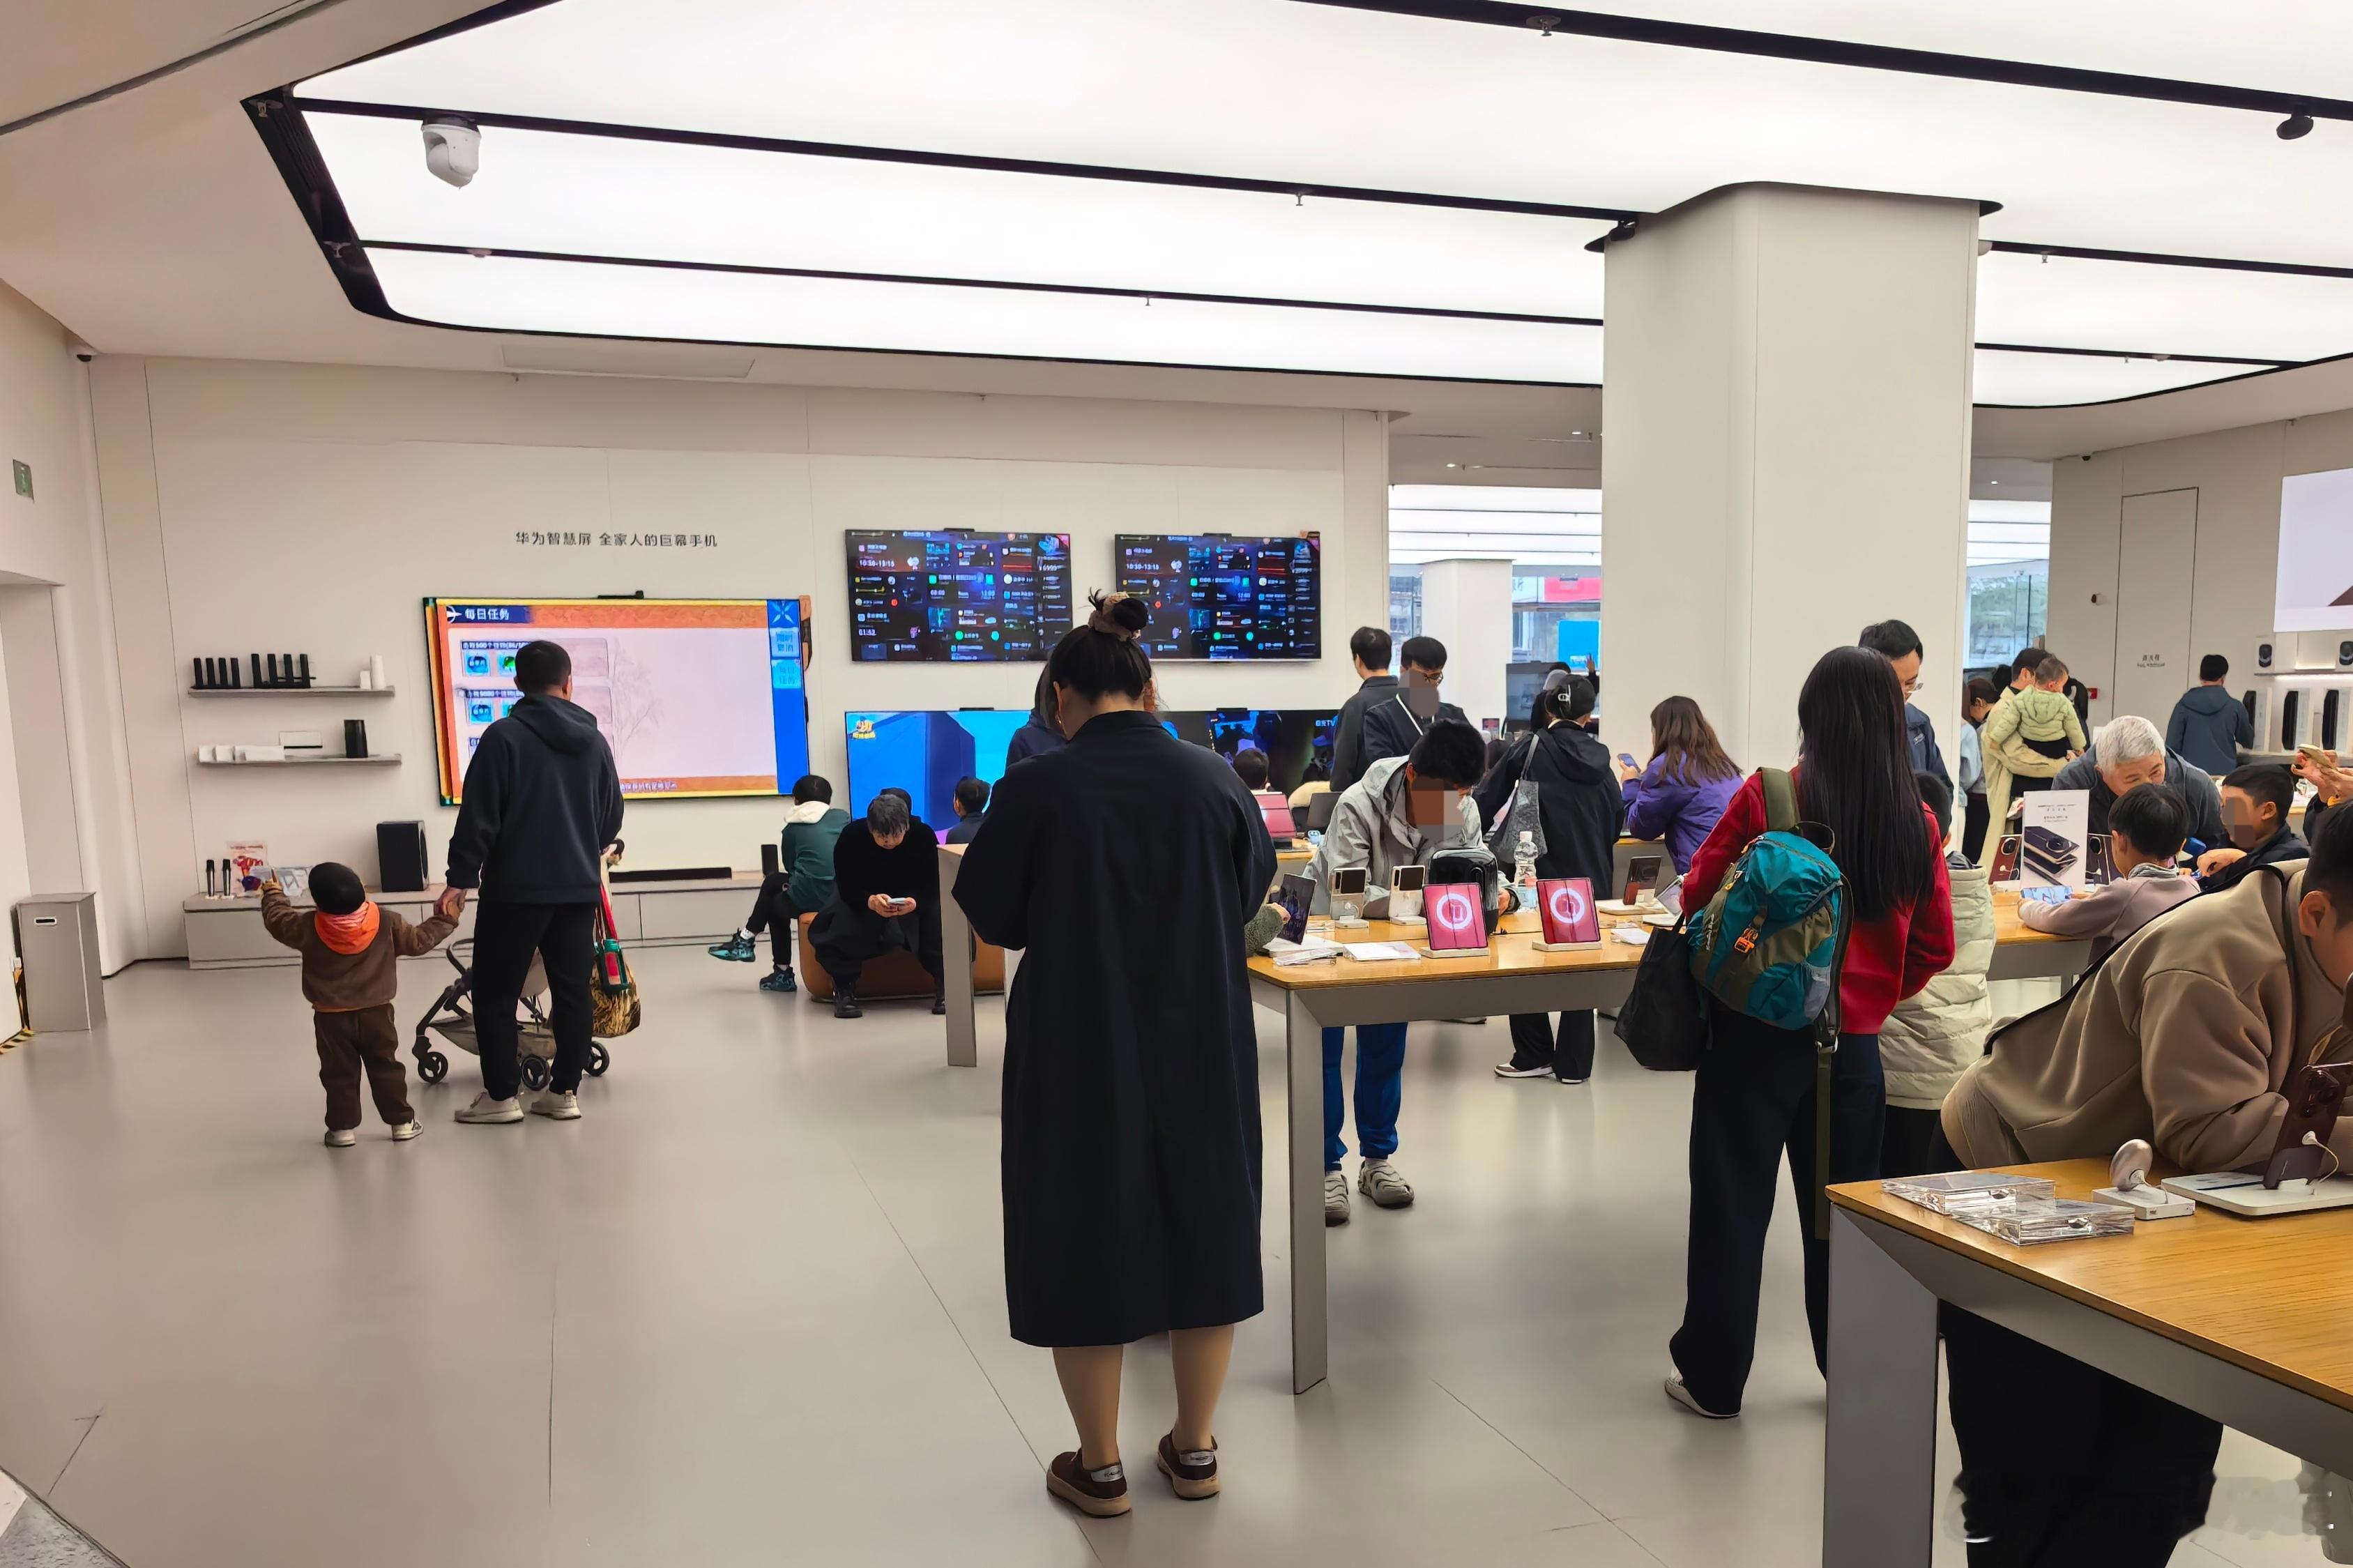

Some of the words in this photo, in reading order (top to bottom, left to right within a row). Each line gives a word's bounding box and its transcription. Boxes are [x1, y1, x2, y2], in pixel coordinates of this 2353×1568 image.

[515, 531, 592, 546] 华为智慧屏
[599, 532, 718, 547] 全家人的巨幕手机
[464, 607, 510, 621] 每日任务
